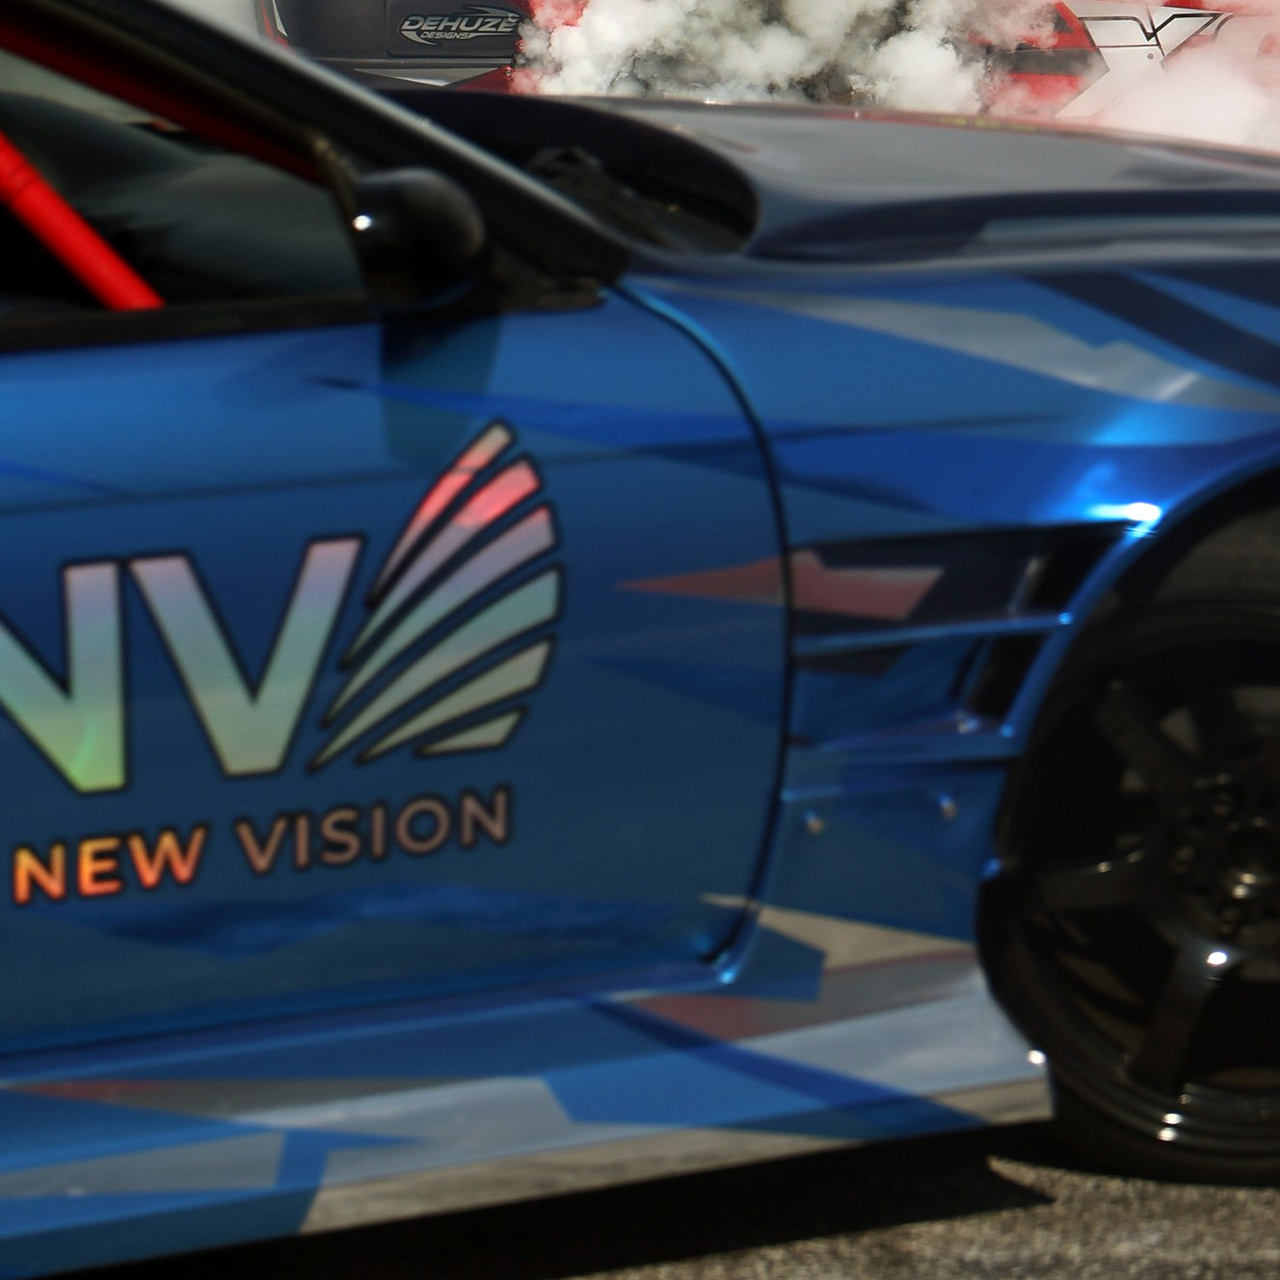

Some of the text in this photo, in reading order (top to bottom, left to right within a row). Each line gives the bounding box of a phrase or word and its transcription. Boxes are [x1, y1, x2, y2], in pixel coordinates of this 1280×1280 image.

[401, 15, 518, 32] DEHUZE
[420, 31, 472, 40] DESIGNS
[13, 787, 511, 904] NEW VISION
